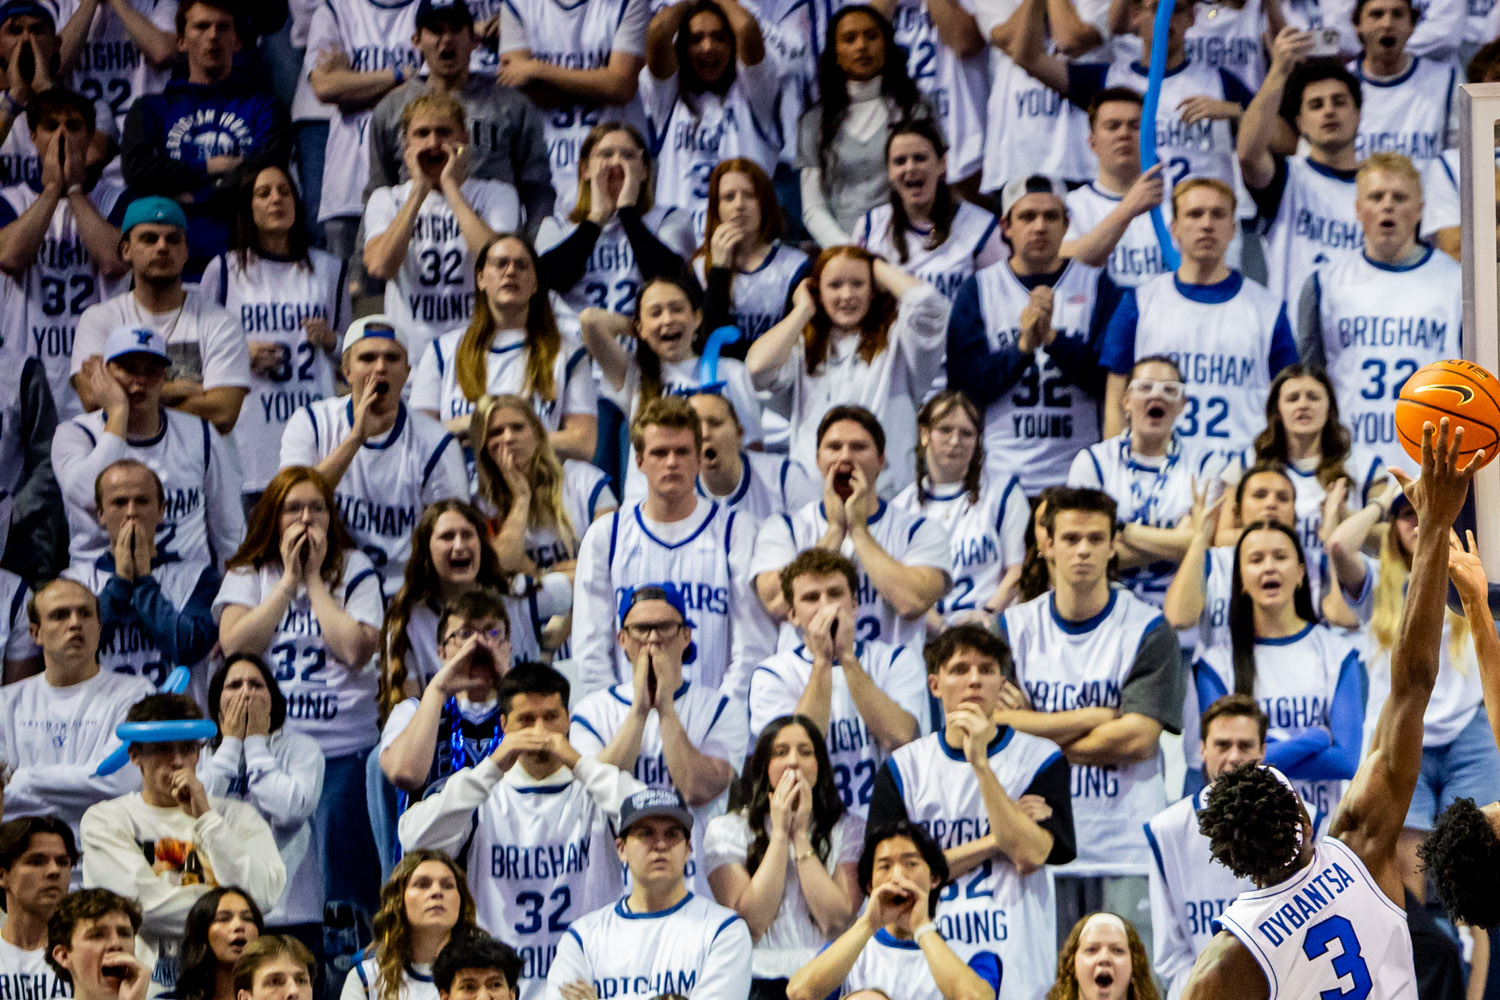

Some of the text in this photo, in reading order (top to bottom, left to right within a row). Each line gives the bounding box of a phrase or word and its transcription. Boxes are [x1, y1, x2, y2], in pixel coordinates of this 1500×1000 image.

[420, 250, 465, 285] 32
[41, 275, 94, 316] 32
[1338, 315, 1447, 350] BRIGHAM
[1013, 415, 1073, 438] YOUNG
[1179, 396, 1231, 438] 32
[1353, 410, 1396, 445] YOU
[272, 645, 328, 682] 32
[491, 841, 592, 880] BRIGHAM
[515, 885, 573, 935] 32
[1258, 863, 1354, 948] DYBANTSA
